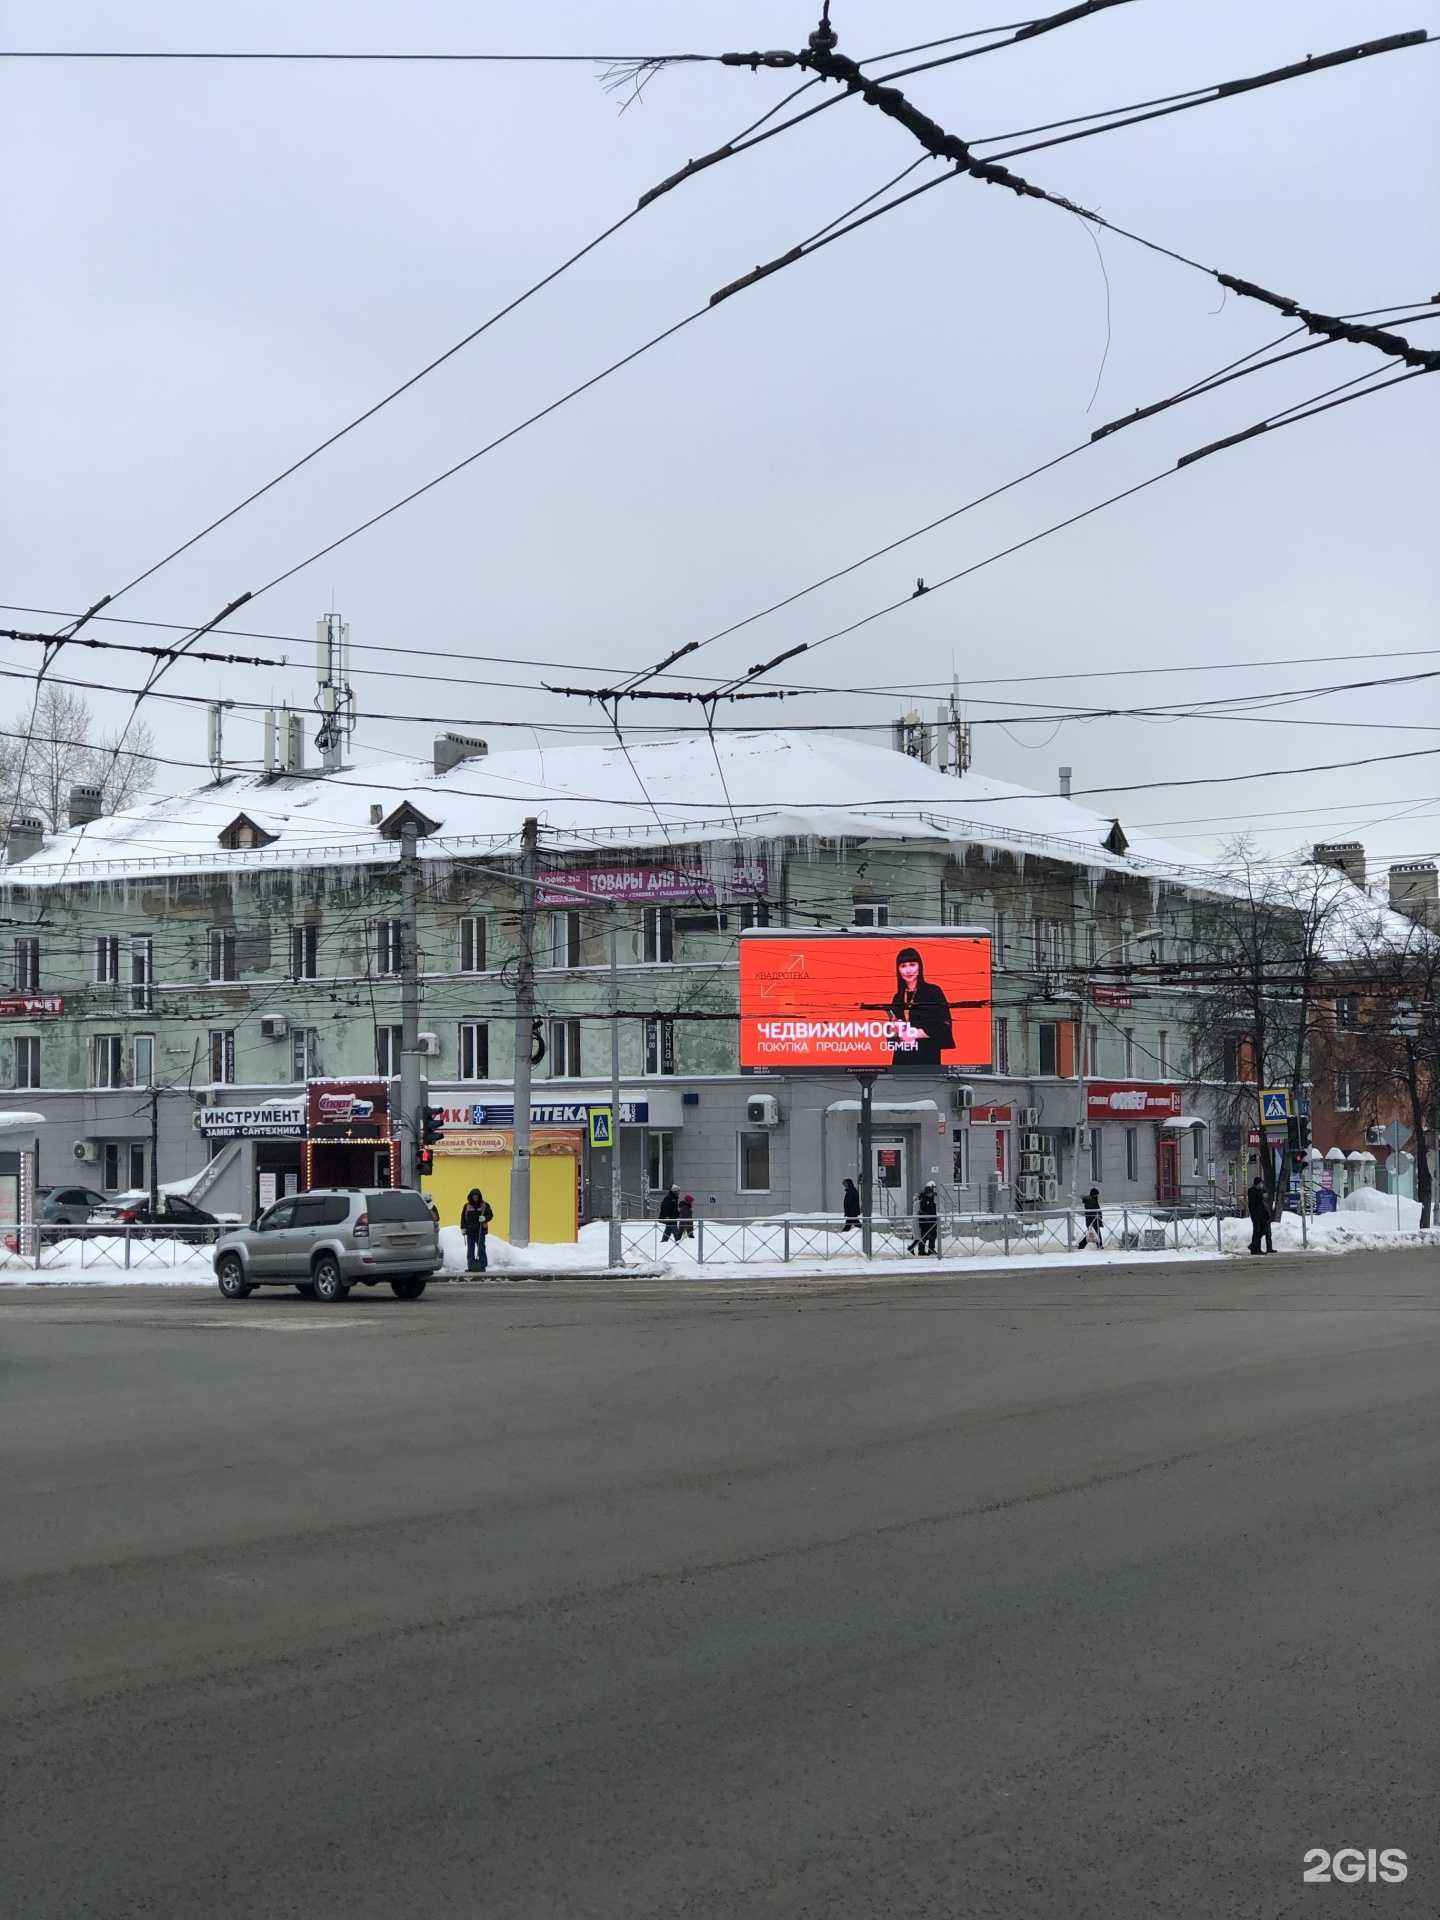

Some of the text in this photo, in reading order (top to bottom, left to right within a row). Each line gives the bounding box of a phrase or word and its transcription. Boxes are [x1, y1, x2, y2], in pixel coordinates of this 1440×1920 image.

[589, 873, 643, 891] ТОВАРЫ
[647, 870, 676, 890] ДЛЯ
[758, 1040, 919, 1053] ПОКУПКА ПРОДАЖА ОБМЕН
[204, 1109, 301, 1125] ИНСТРУМЕНТ
[529, 1106, 588, 1122] ПТЕКА
[206, 1125, 301, 1137] ЗАМКИ САНТЕХНИКА
